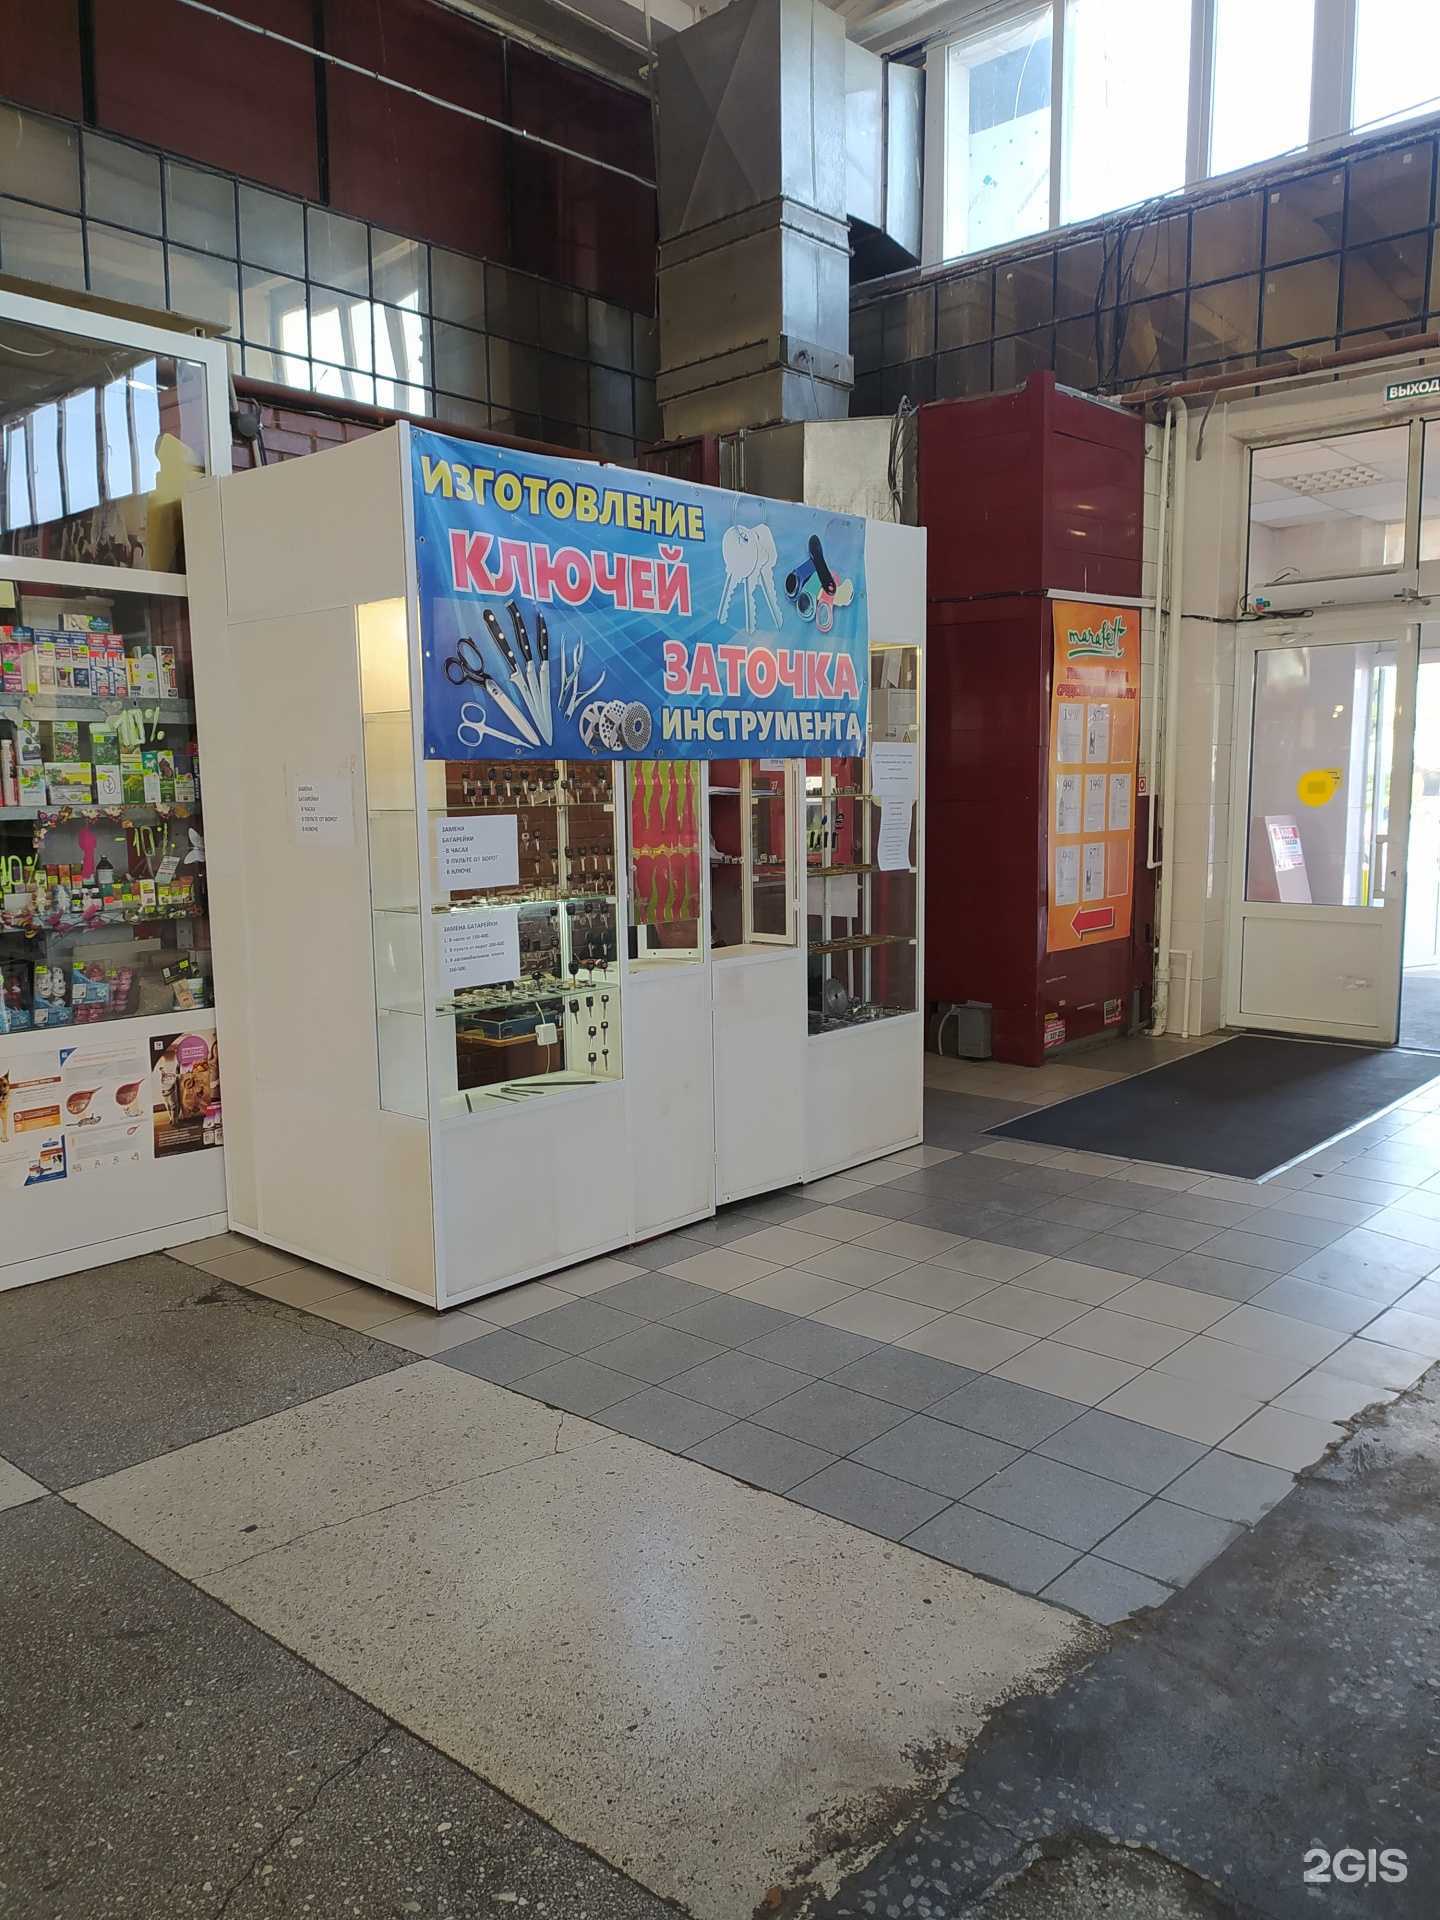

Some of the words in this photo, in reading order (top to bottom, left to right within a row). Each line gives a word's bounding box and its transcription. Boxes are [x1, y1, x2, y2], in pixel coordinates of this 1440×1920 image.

[1390, 379, 1440, 398] ВЫХОД
[420, 454, 705, 541] ИЗГОТОВЛЕНИЕ
[449, 528, 692, 616] КЛЮЧЕЙ
[662, 639, 859, 700] ЗАТОЧКА
[662, 705, 863, 743] ИНСТРУМЕНТА
